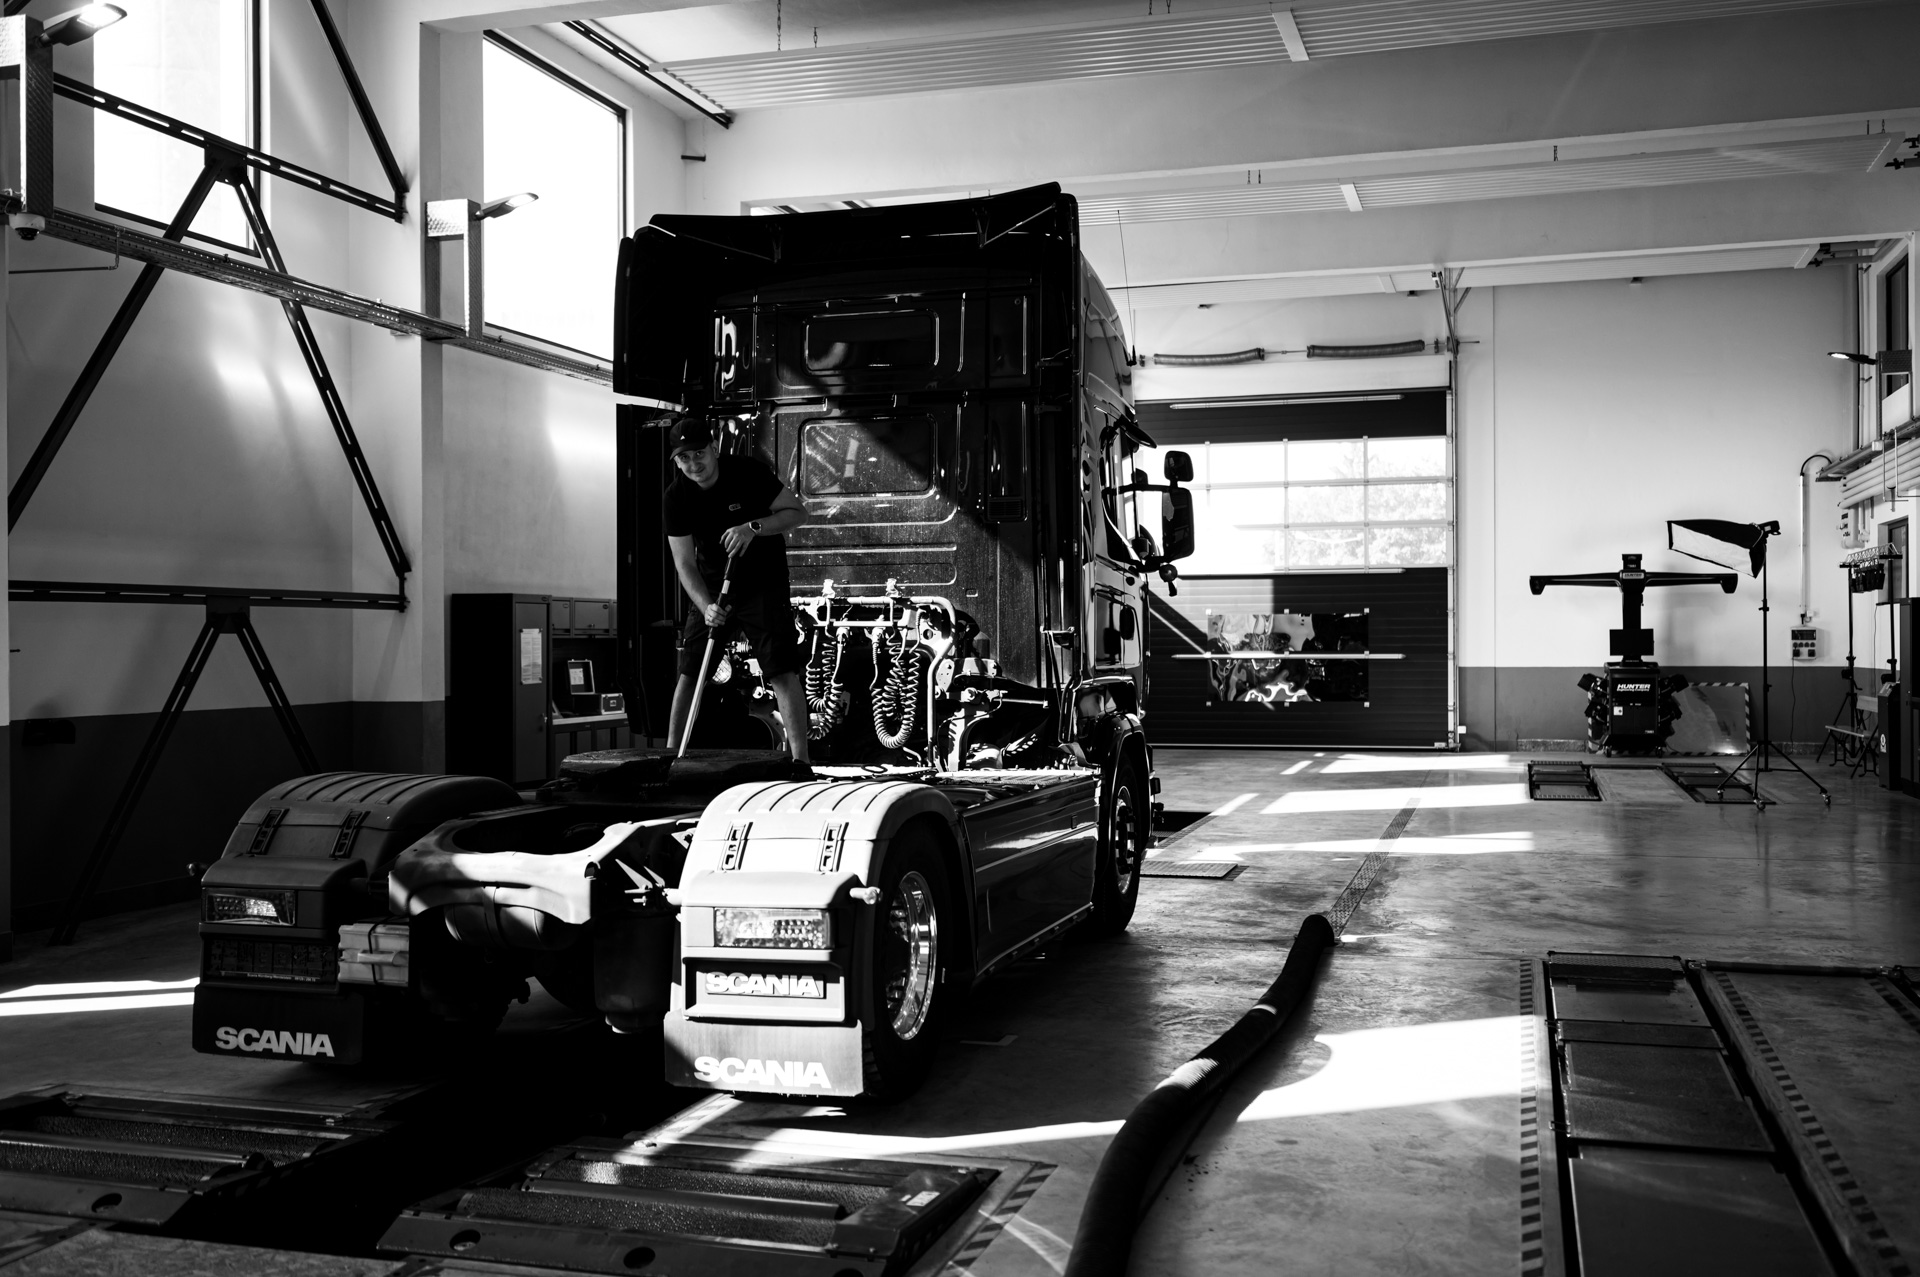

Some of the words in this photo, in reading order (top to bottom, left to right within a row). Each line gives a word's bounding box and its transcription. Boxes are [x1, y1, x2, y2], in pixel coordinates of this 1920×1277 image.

[705, 972, 821, 997] SCANIA
[215, 1026, 335, 1057] SCANIA
[694, 1056, 831, 1089] SCANIA
